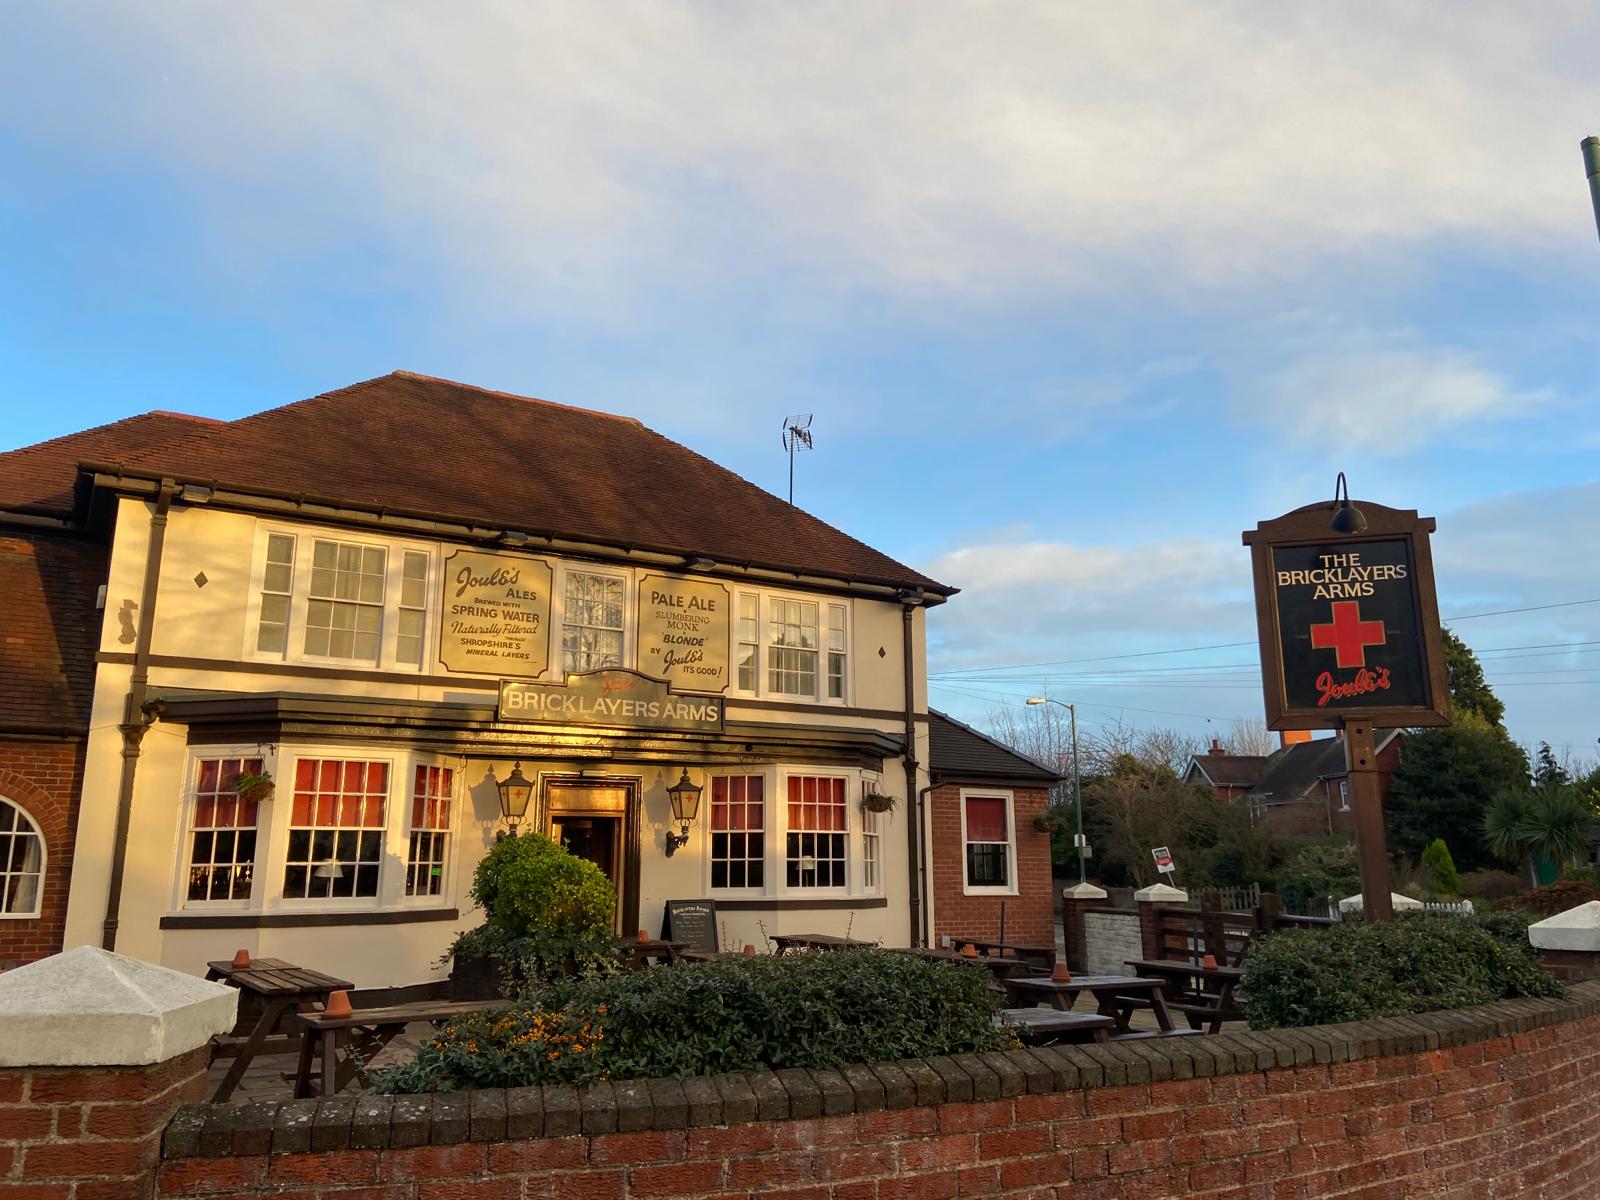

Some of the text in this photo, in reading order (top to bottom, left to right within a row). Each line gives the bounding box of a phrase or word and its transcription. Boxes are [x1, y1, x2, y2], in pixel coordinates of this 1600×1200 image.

[1319, 553, 1361, 567] THE
[1277, 564, 1407, 586] BRICKLAYERS
[506, 588, 537, 600] ALES
[1313, 582, 1375, 600] ARMS
[474, 597, 501, 606] BREWED
[651, 591, 715, 611] PALE ALE
[451, 604, 540, 623] SPRING WATER
[655, 611, 710, 624] SLUMBERING
[451, 621, 539, 637] Naturally Filtered
[667, 621, 699, 632] MONK
[460, 638, 521, 650] SHROPSHIRE'S
[466, 648, 498, 656] MINERAL
[508, 690, 718, 722] BRICKLAYERS ARMS
